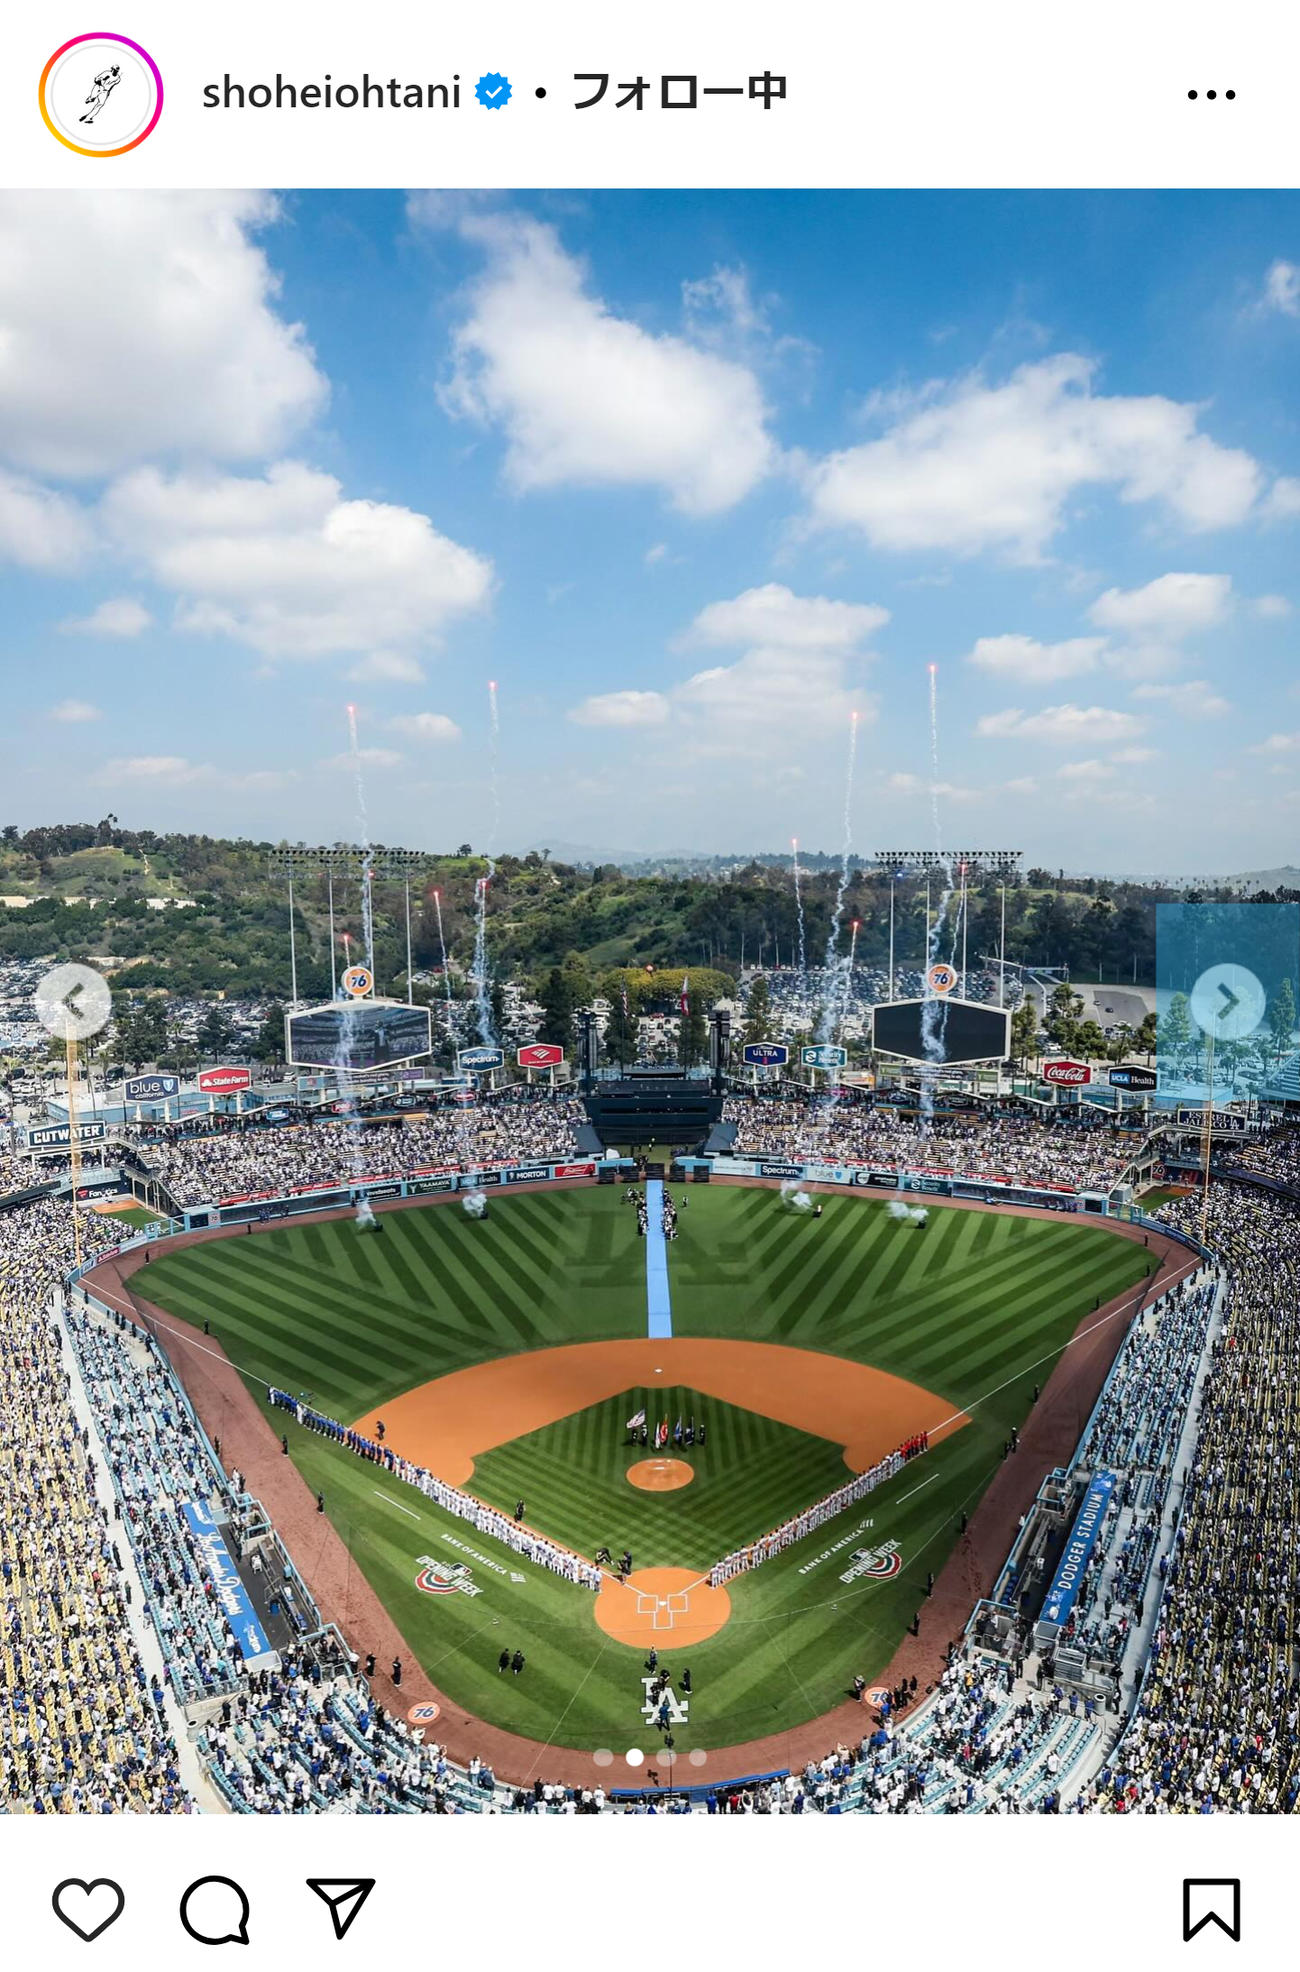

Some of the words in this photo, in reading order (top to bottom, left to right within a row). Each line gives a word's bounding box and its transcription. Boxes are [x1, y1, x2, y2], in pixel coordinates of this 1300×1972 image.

[351, 974, 367, 988] 76
[934, 972, 948, 985] 76
[752, 1049, 778, 1057] ULTRA
[461, 1055, 499, 1066] Spectrum
[1111, 1073, 1129, 1082] UCLA
[1130, 1075, 1155, 1086] Health
[129, 1081, 161, 1094] blue
[134, 1091, 165, 1099] california
[33, 1125, 100, 1144] CUTWATER
[516, 1170, 547, 1180] MORTON
[761, 1164, 800, 1176] Spectrum
[1153, 1165, 1165, 1174] 76
[1057, 1540, 1087, 1590] DODGER
[1076, 1493, 1104, 1539] STADIUM
[440, 1533, 461, 1549] BANK
[471, 1551, 508, 1575] AMERICA
[798, 1558, 823, 1575] BANK
[820, 1550, 832, 1559] OF
[830, 1529, 865, 1553] AMERICA
[838, 1555, 880, 1584] OPENING
[872, 1538, 903, 1558] WEEK
[415, 1555, 458, 1581] OPENING
[453, 1576, 484, 1598] WEEK
[217, 1576, 243, 1616] Dodgers
[641, 1677, 689, 1725] LA
[413, 1706, 435, 1719] 76
